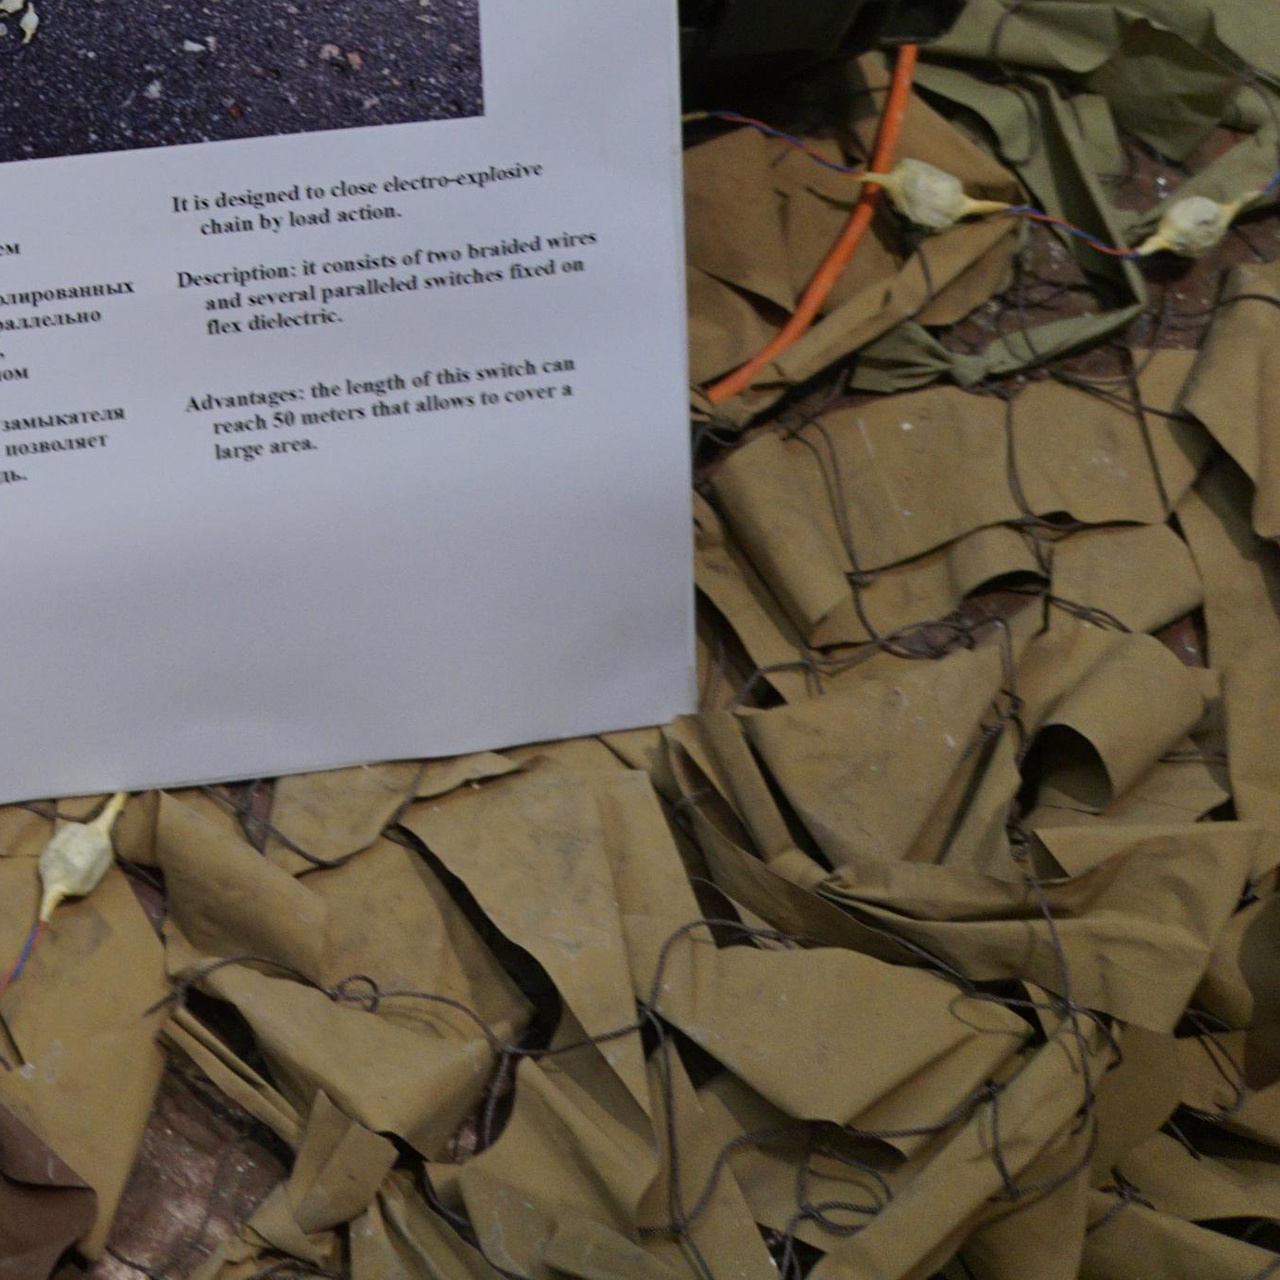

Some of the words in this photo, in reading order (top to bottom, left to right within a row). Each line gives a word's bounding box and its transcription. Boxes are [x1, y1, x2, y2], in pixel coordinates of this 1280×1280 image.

[172, 196, 189, 213] It
[194, 195, 210, 211] is
[214, 184, 301, 209] designed
[305, 185, 326, 200] to
[330, 180, 378, 197] close
[383, 162, 543, 193] electro-explosive
[200, 216, 254, 235] chain
[258, 213, 283, 233] by
[288, 207, 331, 227] load
[337, 204, 402, 223] action.
[176, 264, 297, 288] Description:
[302, 260, 317, 276] it
[322, 254, 397, 274] consists
[401, 249, 424, 266] of
[426, 250, 462, 264] two
[467, 235, 542, 259] braided
[546, 232, 598, 249] wires
[205, 292, 243, 311] and
[248, 284, 317, 307] several
[320, 274, 419, 304] paralleled
[424, 268, 504, 289] switches
[509, 259, 556, 279] fixed
[561, 260, 585, 273] on
[206, 318, 243, 335] flex
[247, 308, 344, 331] dielectric.
[185, 389, 305, 413] Advantages:
[310, 382, 341, 399] the
[345, 374, 406, 397] length
[411, 370, 433, 388] of
[435, 367, 471, 385] this
[476, 359, 537, 381] switch
[541, 359, 576, 373] can
[213, 414, 268, 435] reach
[273, 410, 296, 428] 50
[301, 407, 366, 425] meters
[371, 400, 410, 417] that
[415, 395, 475, 413] allows
[480, 391, 500, 405] to
[504, 386, 557, 403] cover
[562, 385, 573, 396] a
[5, 435, 108, 457] позволяет
[214, 444, 264, 462] large
[269, 439, 318, 454] area.
